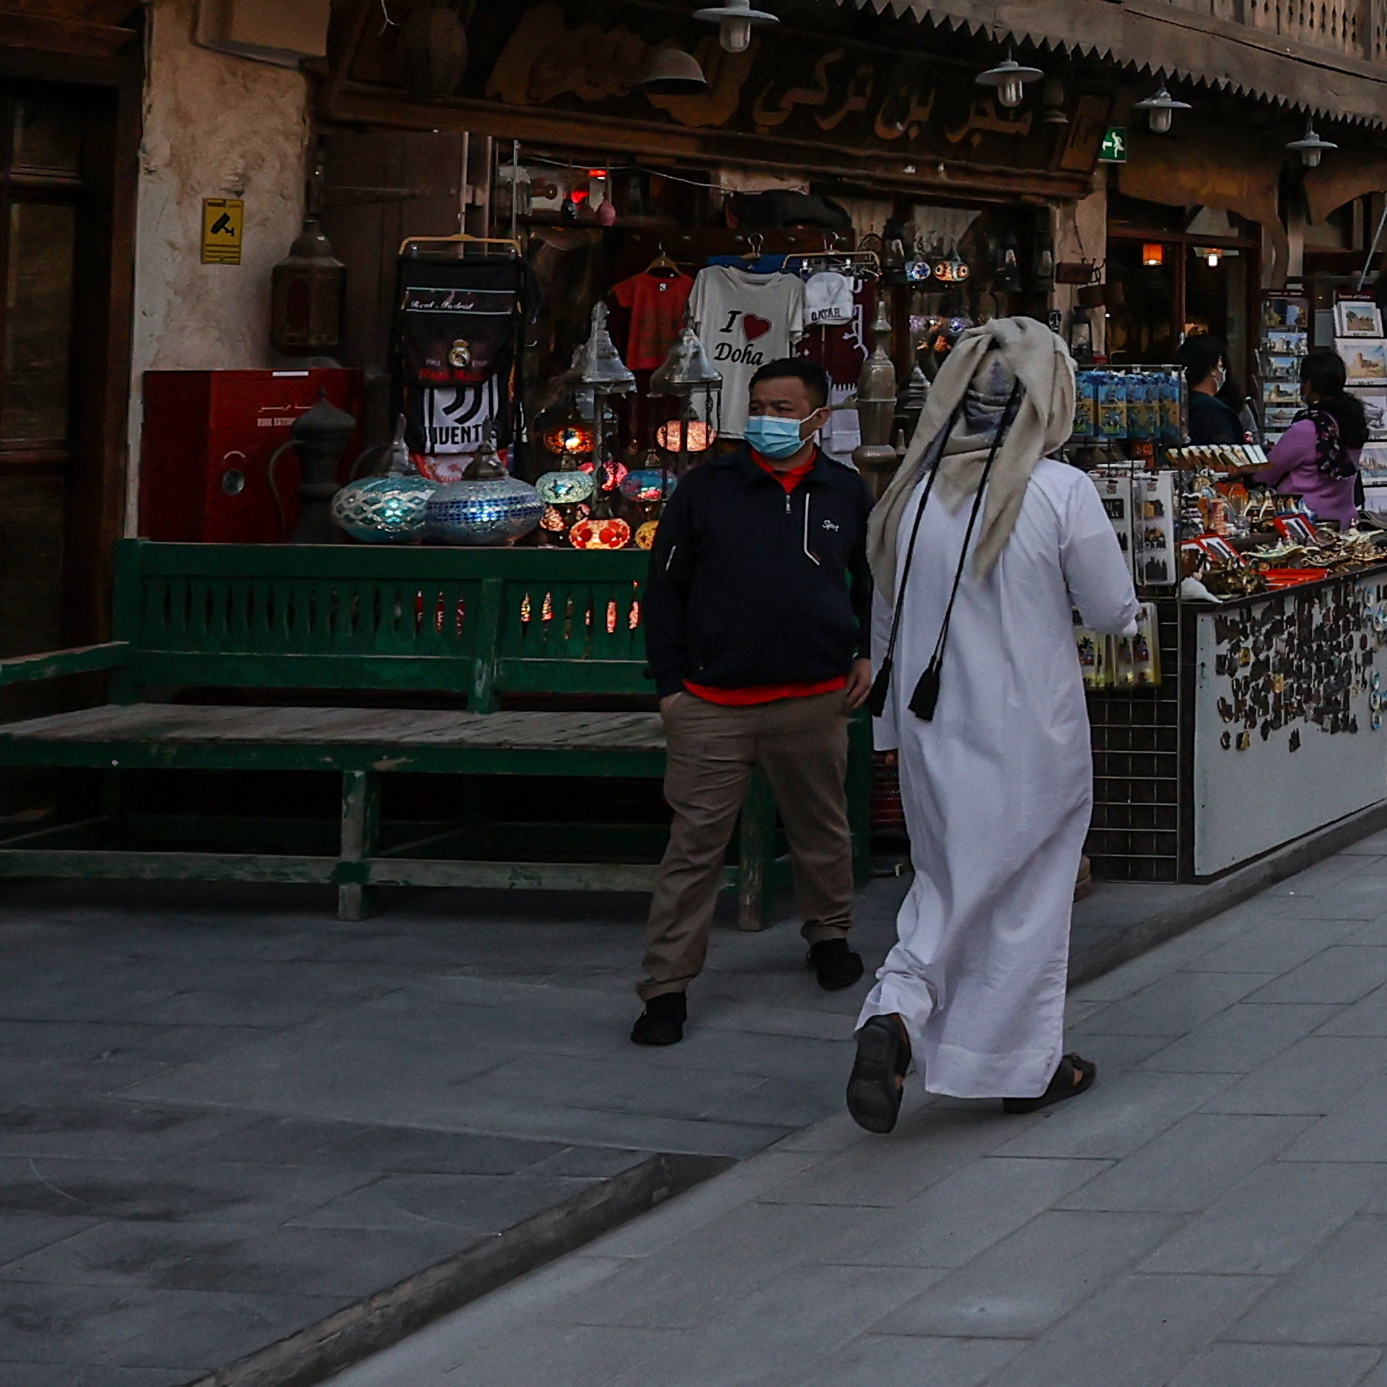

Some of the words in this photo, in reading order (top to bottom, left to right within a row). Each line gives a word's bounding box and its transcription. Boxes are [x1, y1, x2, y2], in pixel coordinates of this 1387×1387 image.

[874, 84, 936, 141] بن
[720, 310, 742, 333] I
[811, 307, 842, 322] QATAR
[714, 342, 764, 366] Doha
[422, 424, 482, 445] JUVENT
